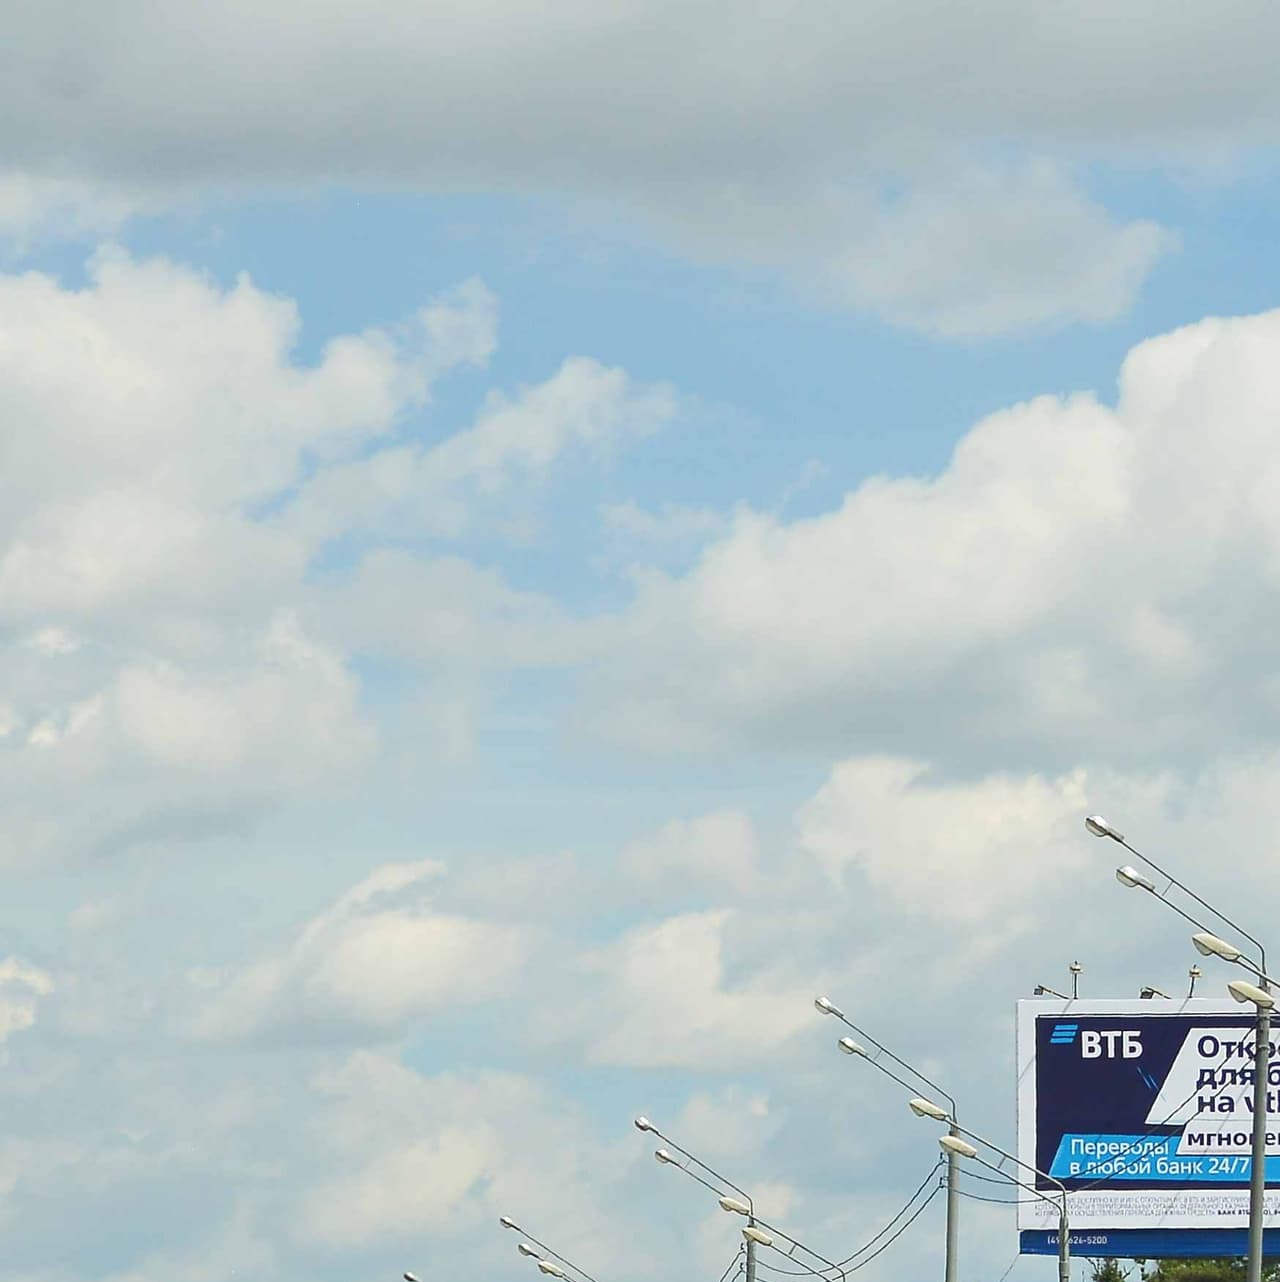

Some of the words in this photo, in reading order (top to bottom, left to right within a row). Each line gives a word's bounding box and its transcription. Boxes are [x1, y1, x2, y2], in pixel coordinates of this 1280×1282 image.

[1081, 1030, 1143, 1059] ВТБ
[1196, 1068, 1257, 1090] для
[1198, 1096, 1235, 1113] на
[1071, 1138, 1169, 1160] Переводы
[1070, 1162, 1081, 1175] в
[1087, 1157, 1151, 1175] любой
[1156, 1157, 1203, 1175] банк
[1209, 1157, 1249, 1175] 24/7
